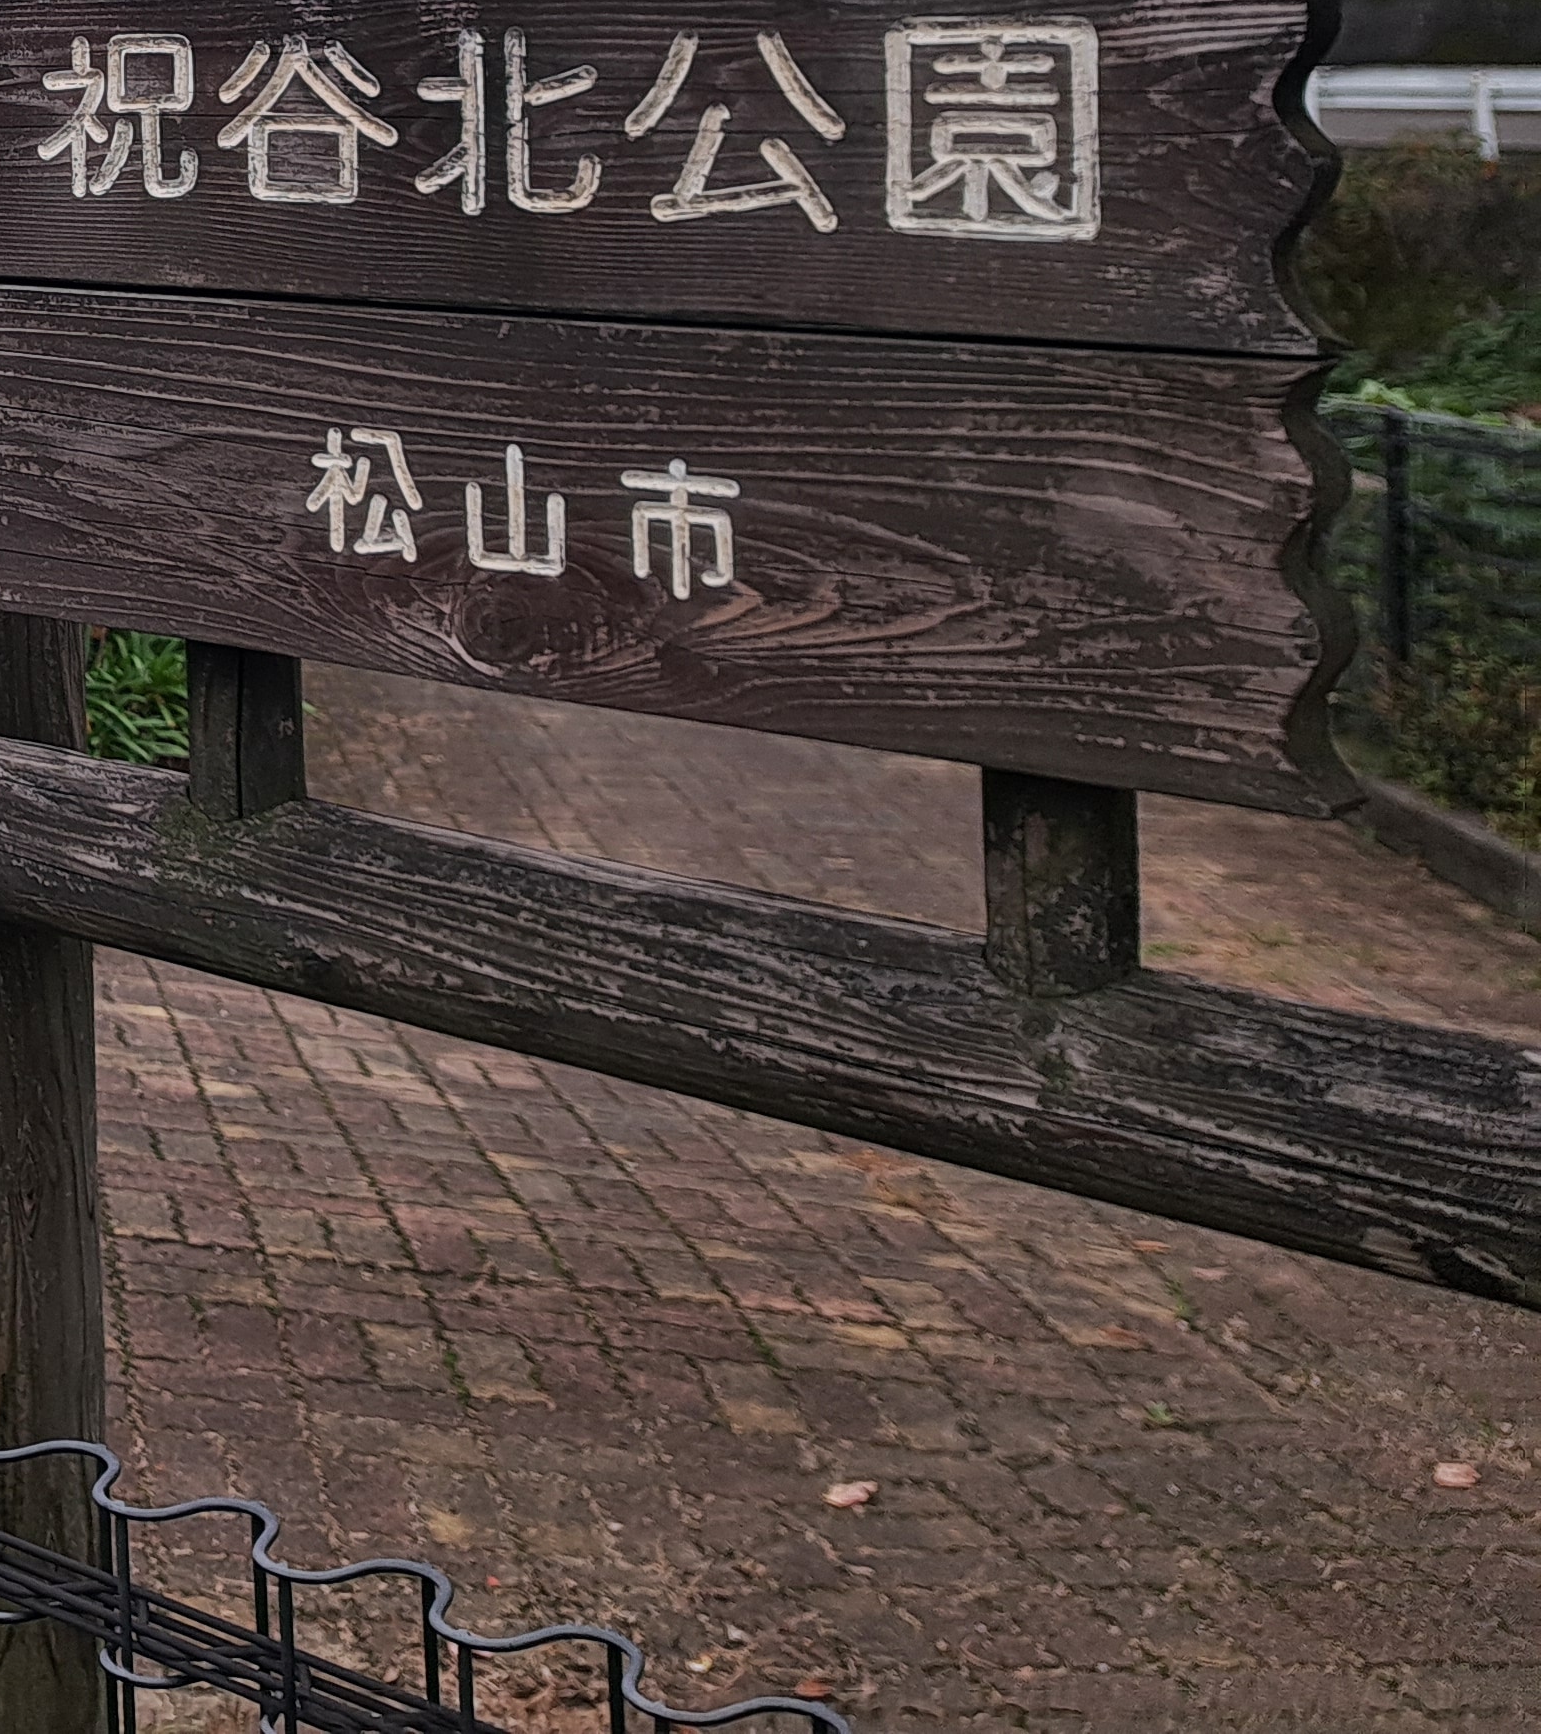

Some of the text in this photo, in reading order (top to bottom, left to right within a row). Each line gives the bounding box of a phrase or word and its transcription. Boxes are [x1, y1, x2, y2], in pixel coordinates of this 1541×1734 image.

[37, 15, 1103, 242] 祝谷北公園
[305, 426, 742, 601] 松山市
